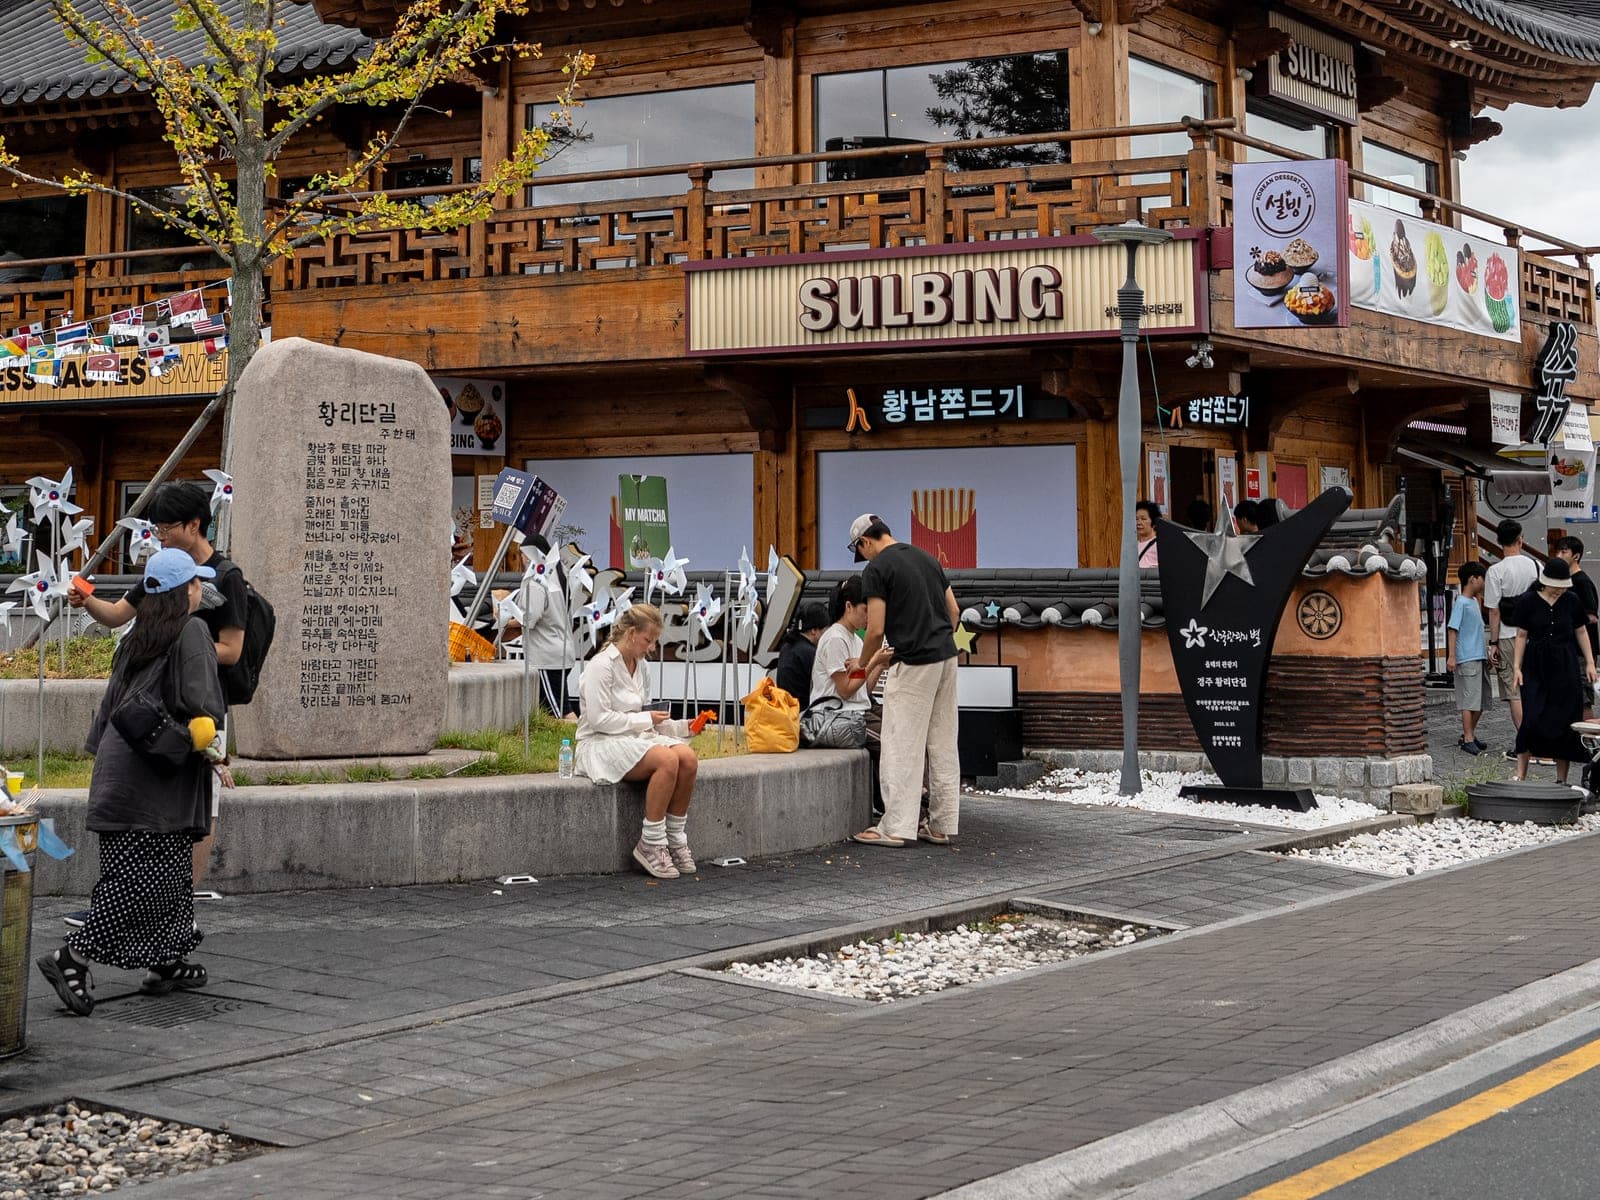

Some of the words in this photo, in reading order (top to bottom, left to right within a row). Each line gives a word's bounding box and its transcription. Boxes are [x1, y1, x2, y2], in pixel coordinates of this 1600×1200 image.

[1288, 41, 1357, 98] SULBING
[1256, 177, 1275, 200] KOREAN
[1275, 175, 1300, 184] DESSERT
[1300, 183, 1311, 198] CAFE
[1265, 192, 1301, 220] 설빙
[800, 264, 1063, 332] SULBING
[882, 385, 1023, 422] 황남쫀드기
[318, 401, 396, 426] 황리단길
[366, 444, 387, 454] 따라
[332, 455, 361, 466] 비단길
[331, 467, 350, 477] 커피
[371, 467, 390, 479] 내음
[1554, 500, 1585, 509] SULBING
[305, 508, 335, 519] 오래된
[341, 508, 369, 519] 기와집
[624, 508, 636, 521] MY
[637, 508, 666, 522] MATCHA
[339, 550, 359, 560] 아는
[364, 550, 374, 562] 양
[304, 562, 324, 572] 지난
[303, 574, 333, 585] 새로운
[363, 574, 383, 585] 되어
[348, 586, 397, 597] 미소지으니
[303, 604, 332, 615] 서라벌
[301, 659, 341, 671] 바람타고
[300, 672, 341, 683] 천마타고
[300, 684, 330, 694] 지구촌
[336, 683, 366, 694] 끝까지
[300, 695, 341, 708] 황리단길
[346, 694, 376, 706] 가슴에
